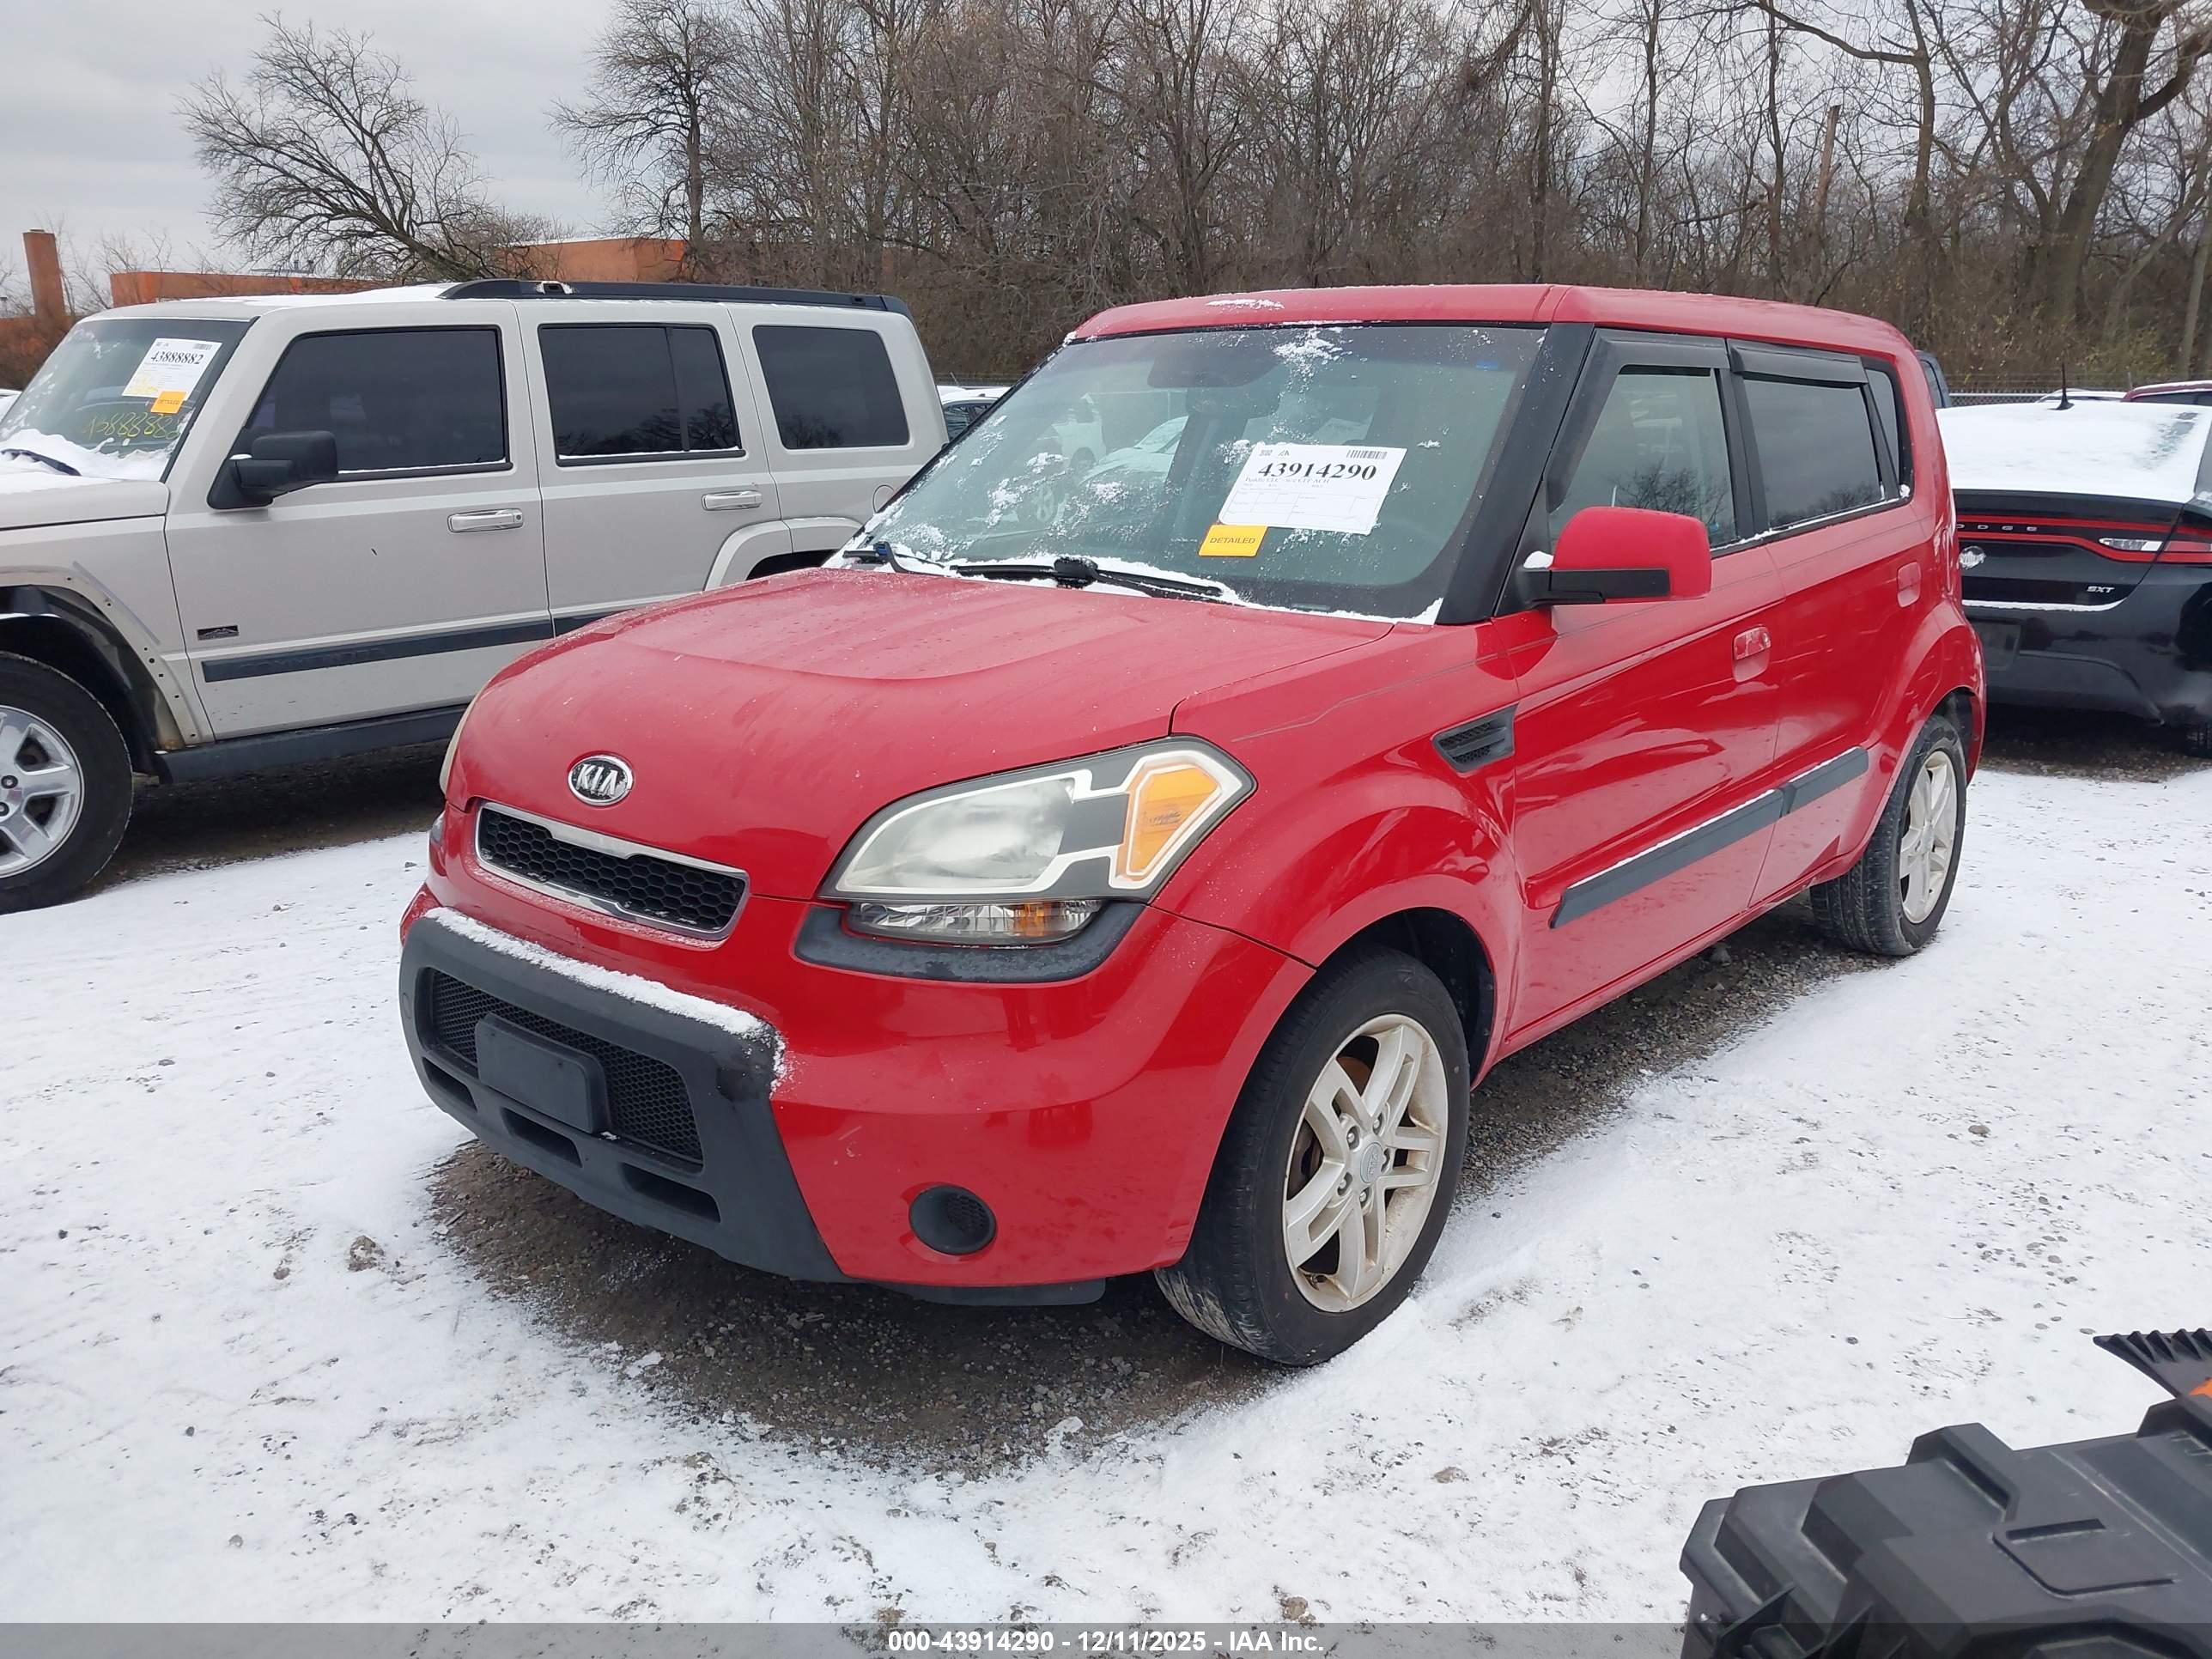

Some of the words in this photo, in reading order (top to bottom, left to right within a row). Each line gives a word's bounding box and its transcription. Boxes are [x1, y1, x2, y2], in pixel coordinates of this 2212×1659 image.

[149, 350, 204, 365] 43888882
[1258, 462, 1377, 481] 43914290
[2087, 585, 2115, 594] SXT
[575, 763, 619, 798] KIA
